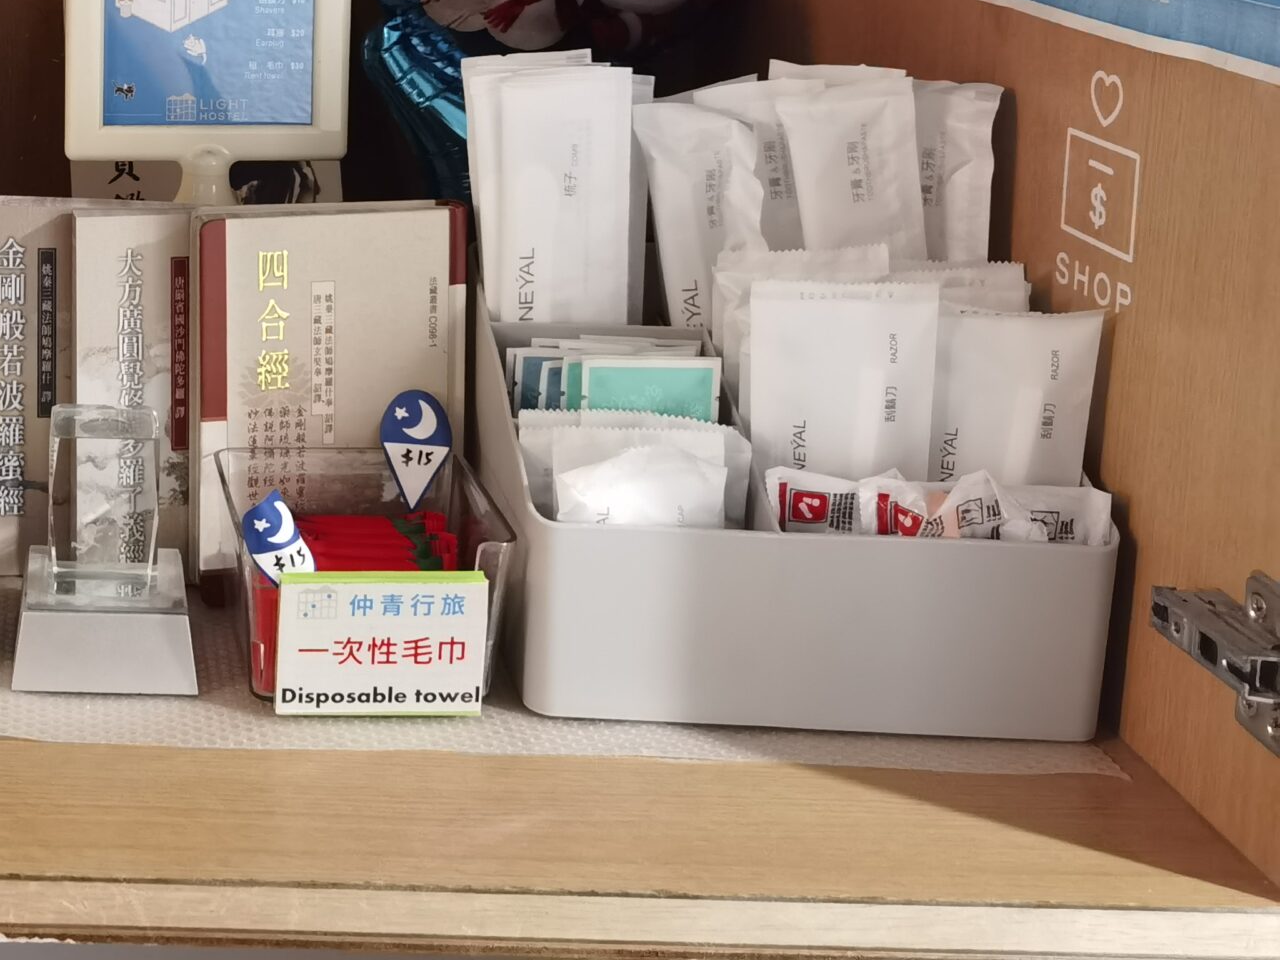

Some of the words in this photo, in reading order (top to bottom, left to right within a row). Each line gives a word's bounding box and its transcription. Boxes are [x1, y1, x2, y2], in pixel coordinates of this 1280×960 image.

[200, 98, 248, 110] LIGHT
[200, 111, 248, 121] HOSTEL
[1055, 251, 1132, 314] SHOP
[256, 248, 291, 392] 四合經
[889, 333, 897, 364] RAZOR
[1050, 349, 1060, 381] RAZOR
[400, 448, 435, 466] $15
[273, 546, 307, 573] $15
[349, 593, 466, 617] 仲青行旅
[297, 636, 467, 666] 一次性毛巾
[281, 686, 407, 708] Disposable
[414, 686, 480, 705] towel
